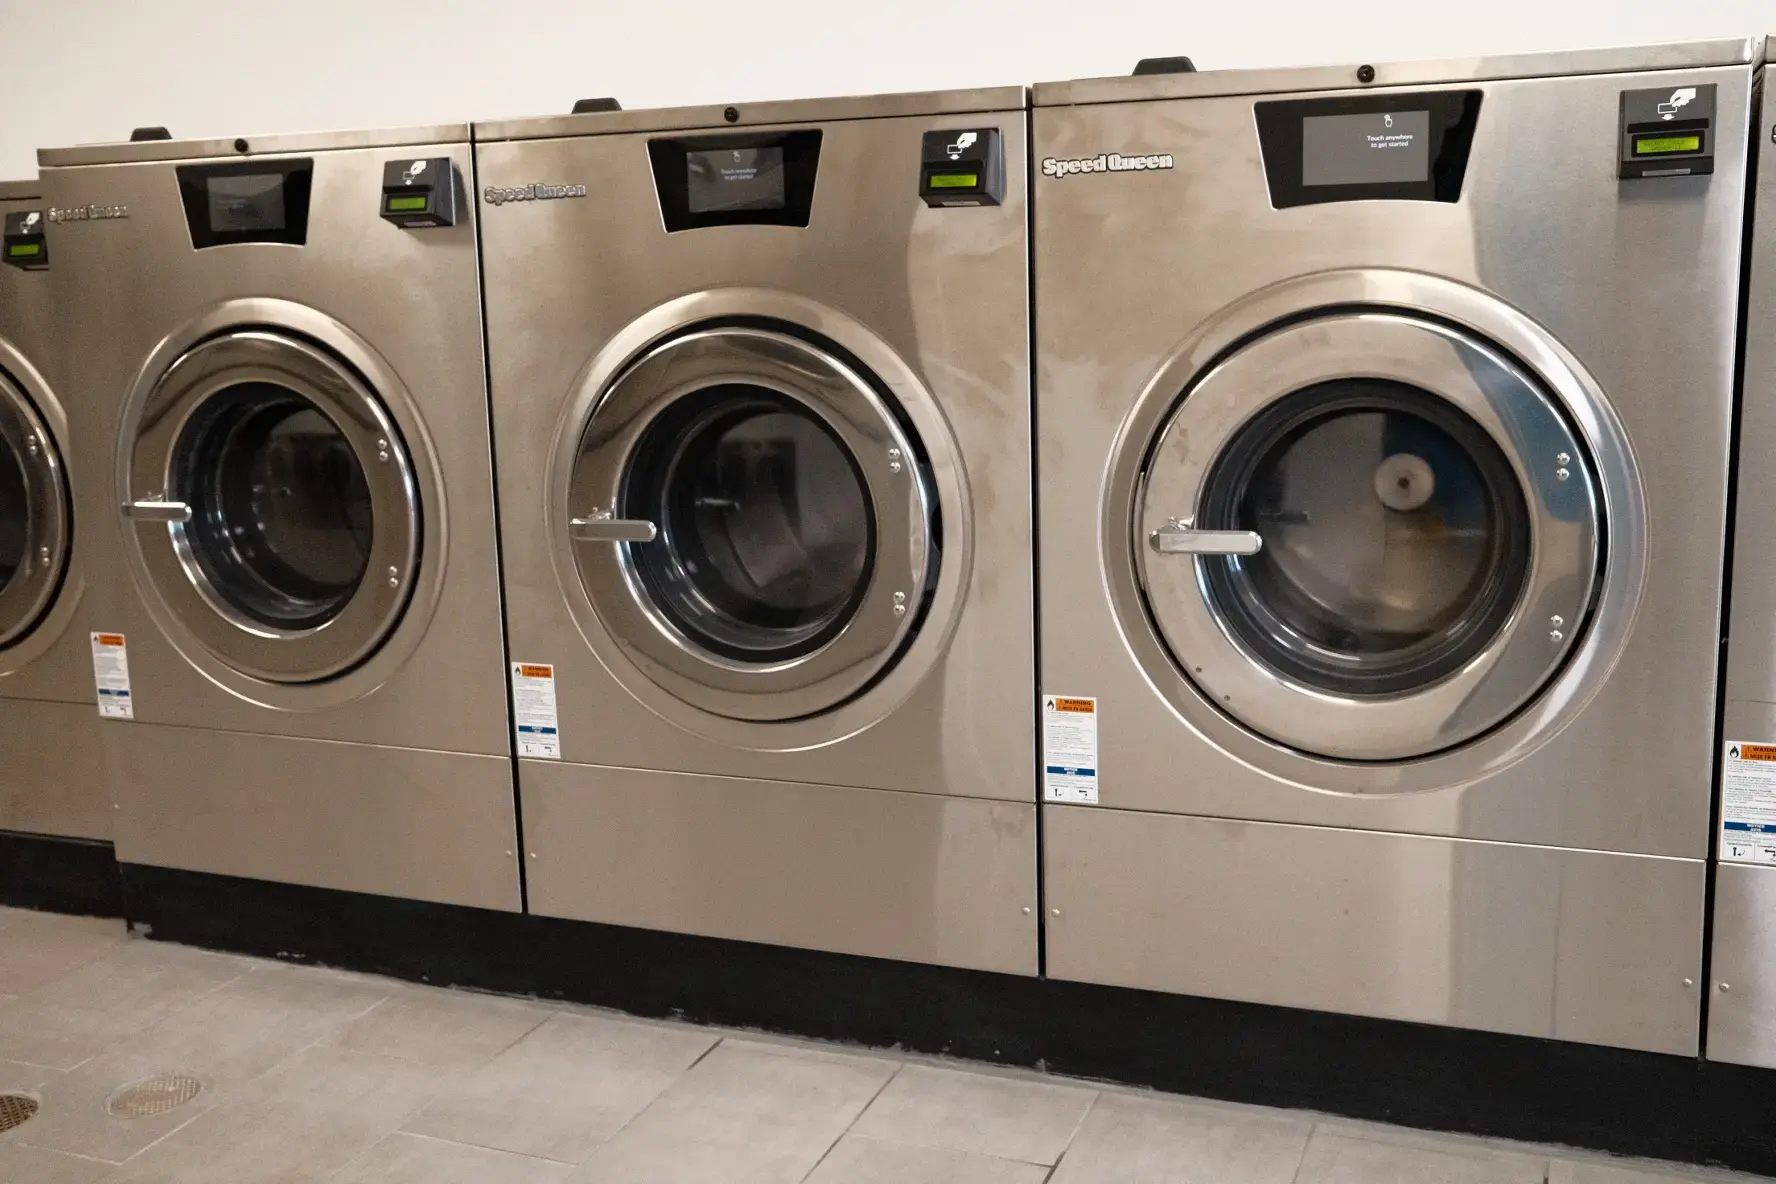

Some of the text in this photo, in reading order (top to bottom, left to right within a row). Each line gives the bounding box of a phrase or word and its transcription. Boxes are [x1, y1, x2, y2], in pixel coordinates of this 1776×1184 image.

[1042, 153, 1173, 178] Speed Queen
[484, 182, 586, 206] Speed Queen
[47, 205, 88, 225] Speed
